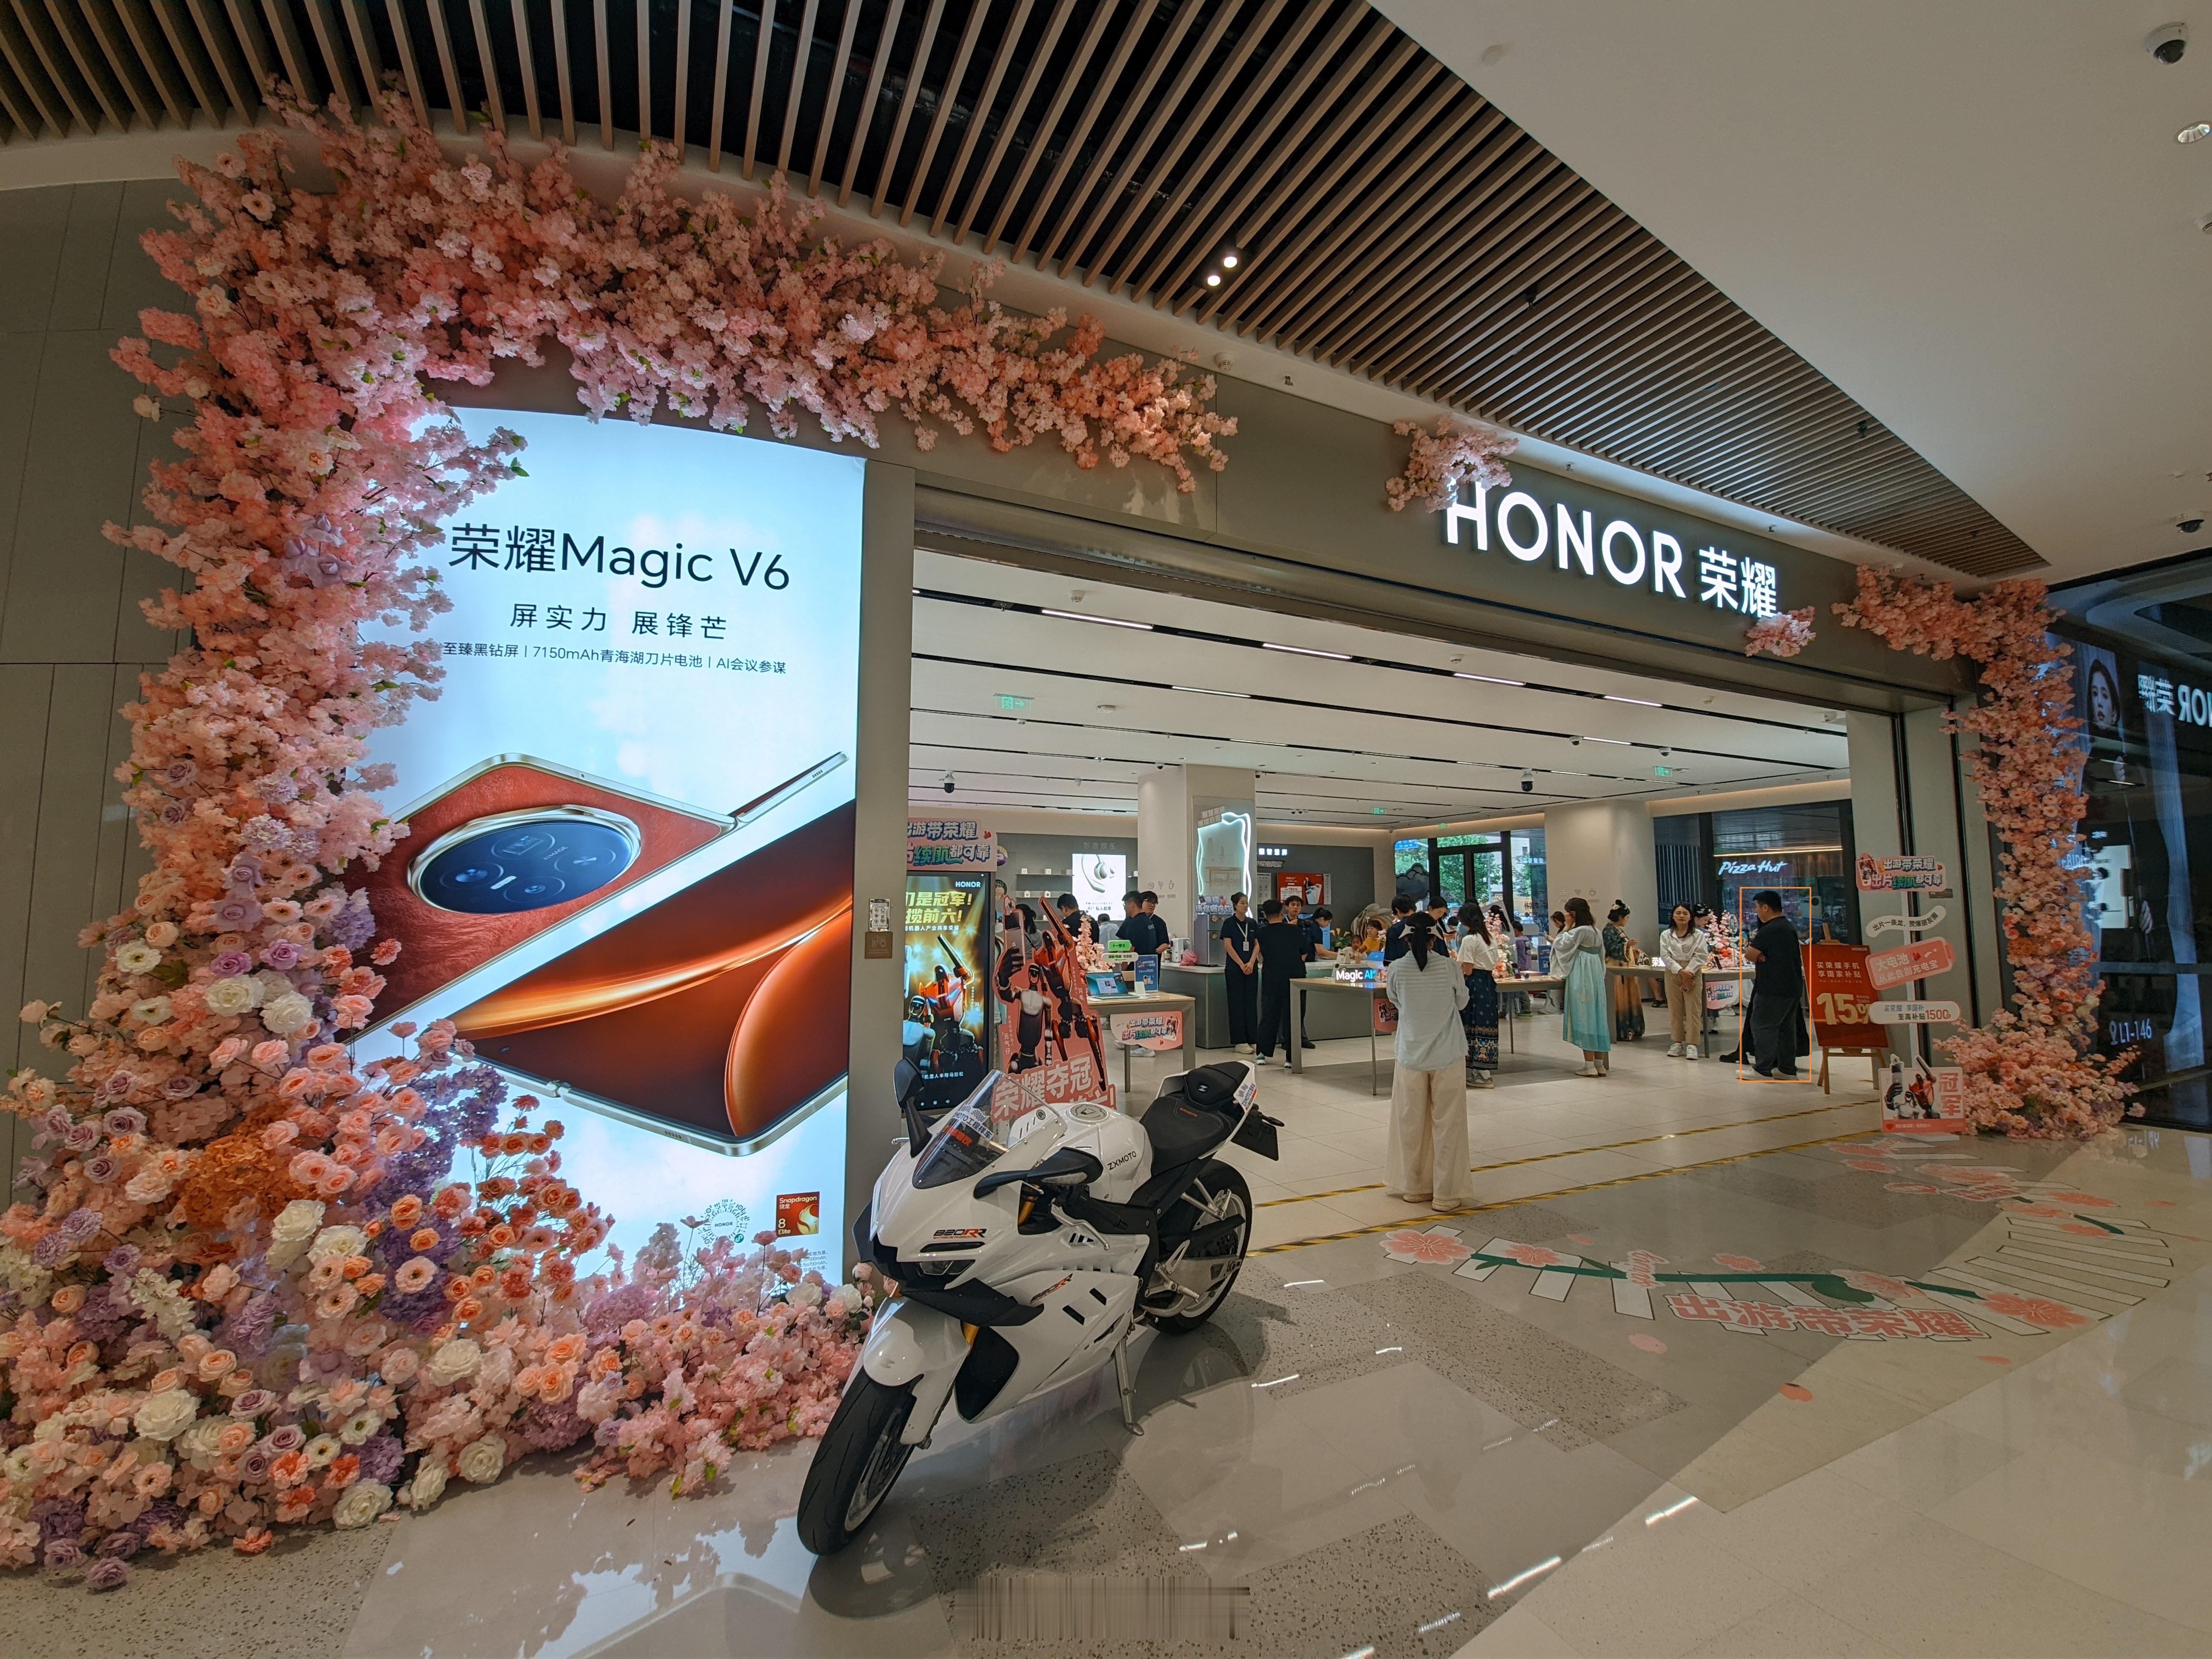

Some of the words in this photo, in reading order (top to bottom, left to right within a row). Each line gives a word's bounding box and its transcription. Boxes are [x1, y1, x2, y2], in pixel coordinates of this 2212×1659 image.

[448, 523, 713, 588] 荣耀Magic
[730, 548, 790, 590] V6
[1447, 482, 1686, 598] HONOR
[1699, 546, 1778, 618] 荣耀
[509, 604, 606, 632] 屏实力
[631, 611, 727, 640] 展锋芒
[443, 641, 519, 658] 至臻黑钻屏
[533, 645, 703, 669] 7150mAh青海湖刀片电池
[716, 658, 787, 675] AI会议参谋
[1718, 861, 1756, 875] Pizza
[1757, 860, 1788, 873] Hut
[1883, 858, 1936, 871] 出游带荣耀
[1876, 953, 1909, 972] 大电池
[1878, 960, 1939, 983] 从此告别充电宝
[1336, 970, 1363, 982] Magic
[993, 1056, 1092, 1120] 荣耀夺冠
[1938, 1072, 1962, 1116] 冠军
[1179, 1107, 1198, 1117] ZXMOTO
[1107, 1151, 1137, 1171] ZXMOTO
[779, 1196, 817, 1205] Snapdragon
[778, 1218, 786, 1229] 8
[933, 1229, 987, 1238] 820RR
[1670, 1295, 1985, 1337] 出游带荣耀
